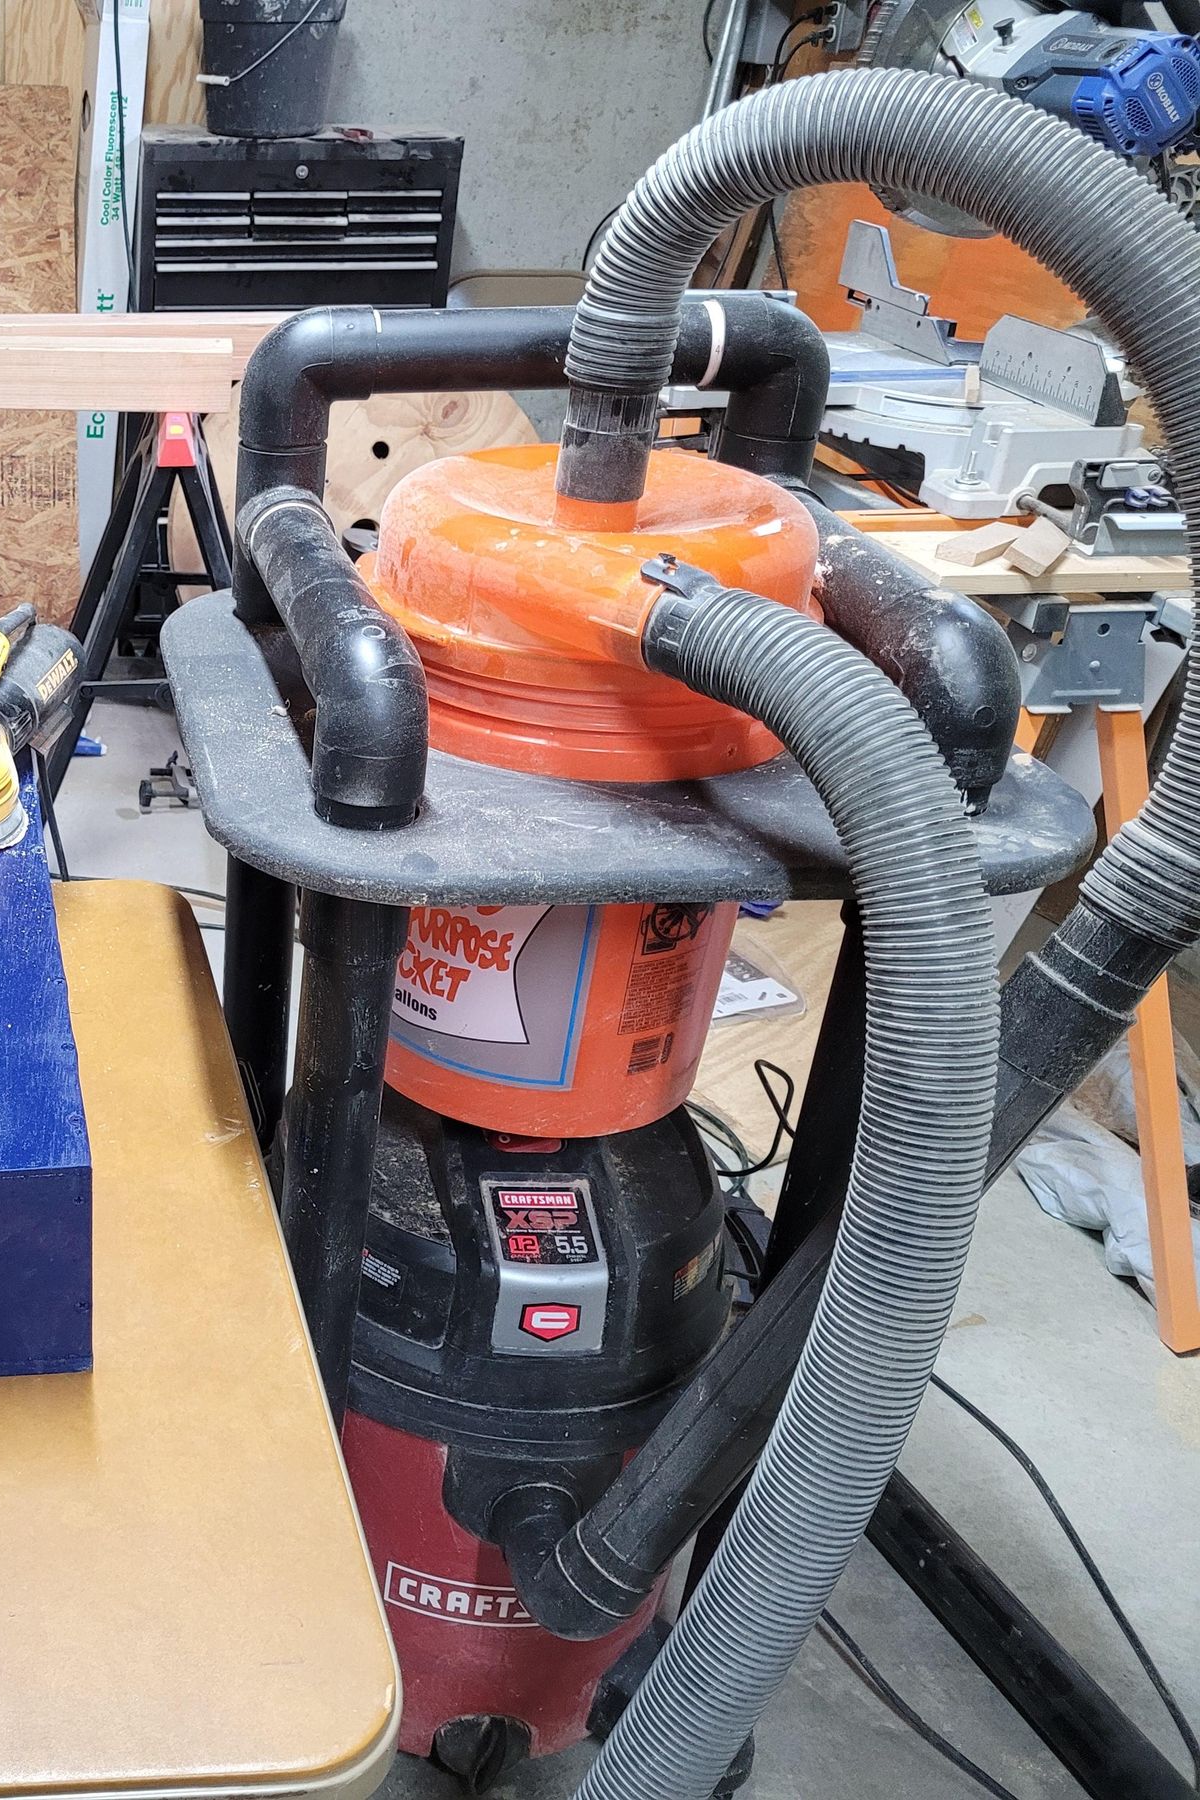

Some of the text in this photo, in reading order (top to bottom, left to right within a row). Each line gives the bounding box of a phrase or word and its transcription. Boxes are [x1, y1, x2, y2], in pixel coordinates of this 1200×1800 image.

[1156, 87, 1180, 123] KOBALT
[100, 91, 119, 226] Cool Color Fluorescent
[112, 177, 122, 204] Watt
[111, 206, 120, 221] 34
[398, 940, 472, 1003] CKET
[394, 988, 438, 1021] allons
[503, 1195, 572, 1205] CRAFTSMAN
[503, 1210, 578, 1230] XSP
[511, 1237, 537, 1252] 12
[554, 1236, 589, 1254] 5.5
[399, 1576, 532, 1619] CRAFT
